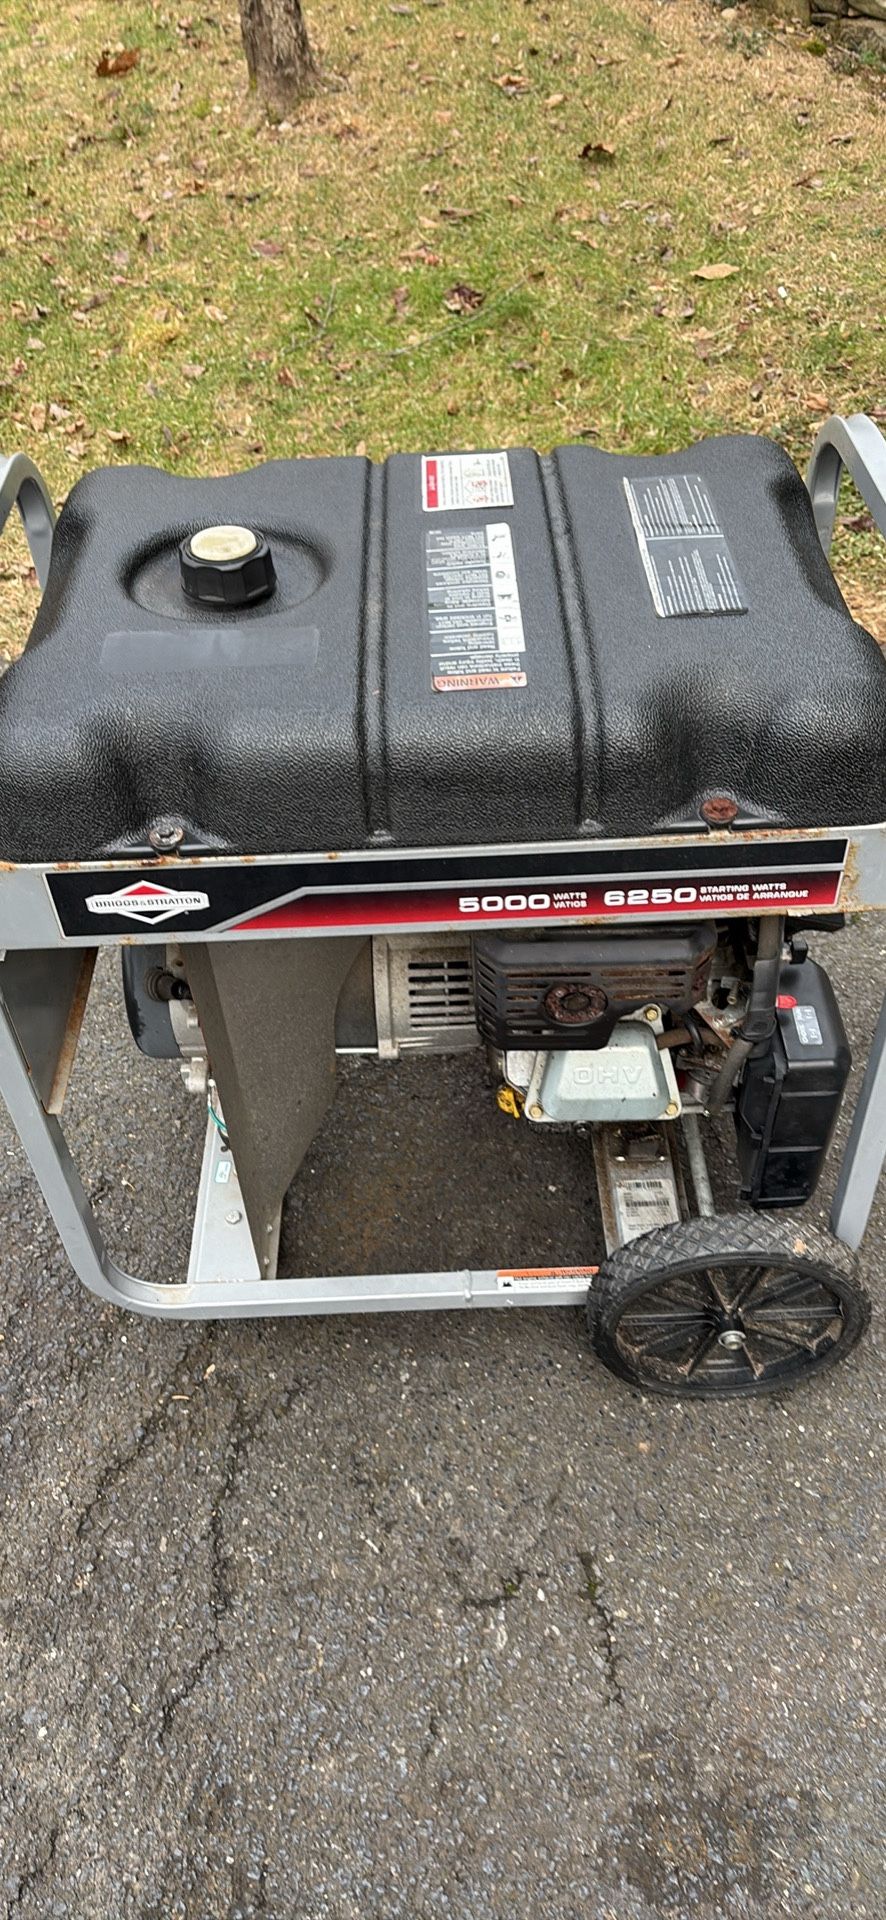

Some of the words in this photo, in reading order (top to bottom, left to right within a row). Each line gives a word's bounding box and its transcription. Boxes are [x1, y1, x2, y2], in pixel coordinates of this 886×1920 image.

[436, 676, 499, 688] WARNING
[700, 884, 750, 894] STARTING
[752, 882, 786, 891] WATTS
[553, 892, 588, 900] WATTS
[604, 888, 698, 906] 6250
[700, 894, 734, 902] VATIOS
[736, 892, 750, 900] DE
[753, 890, 809, 900] ARRANQUE
[458, 894, 550, 912] 5000
[553, 900, 588, 909] VATIOS
[573, 1066, 643, 1084] OHV
